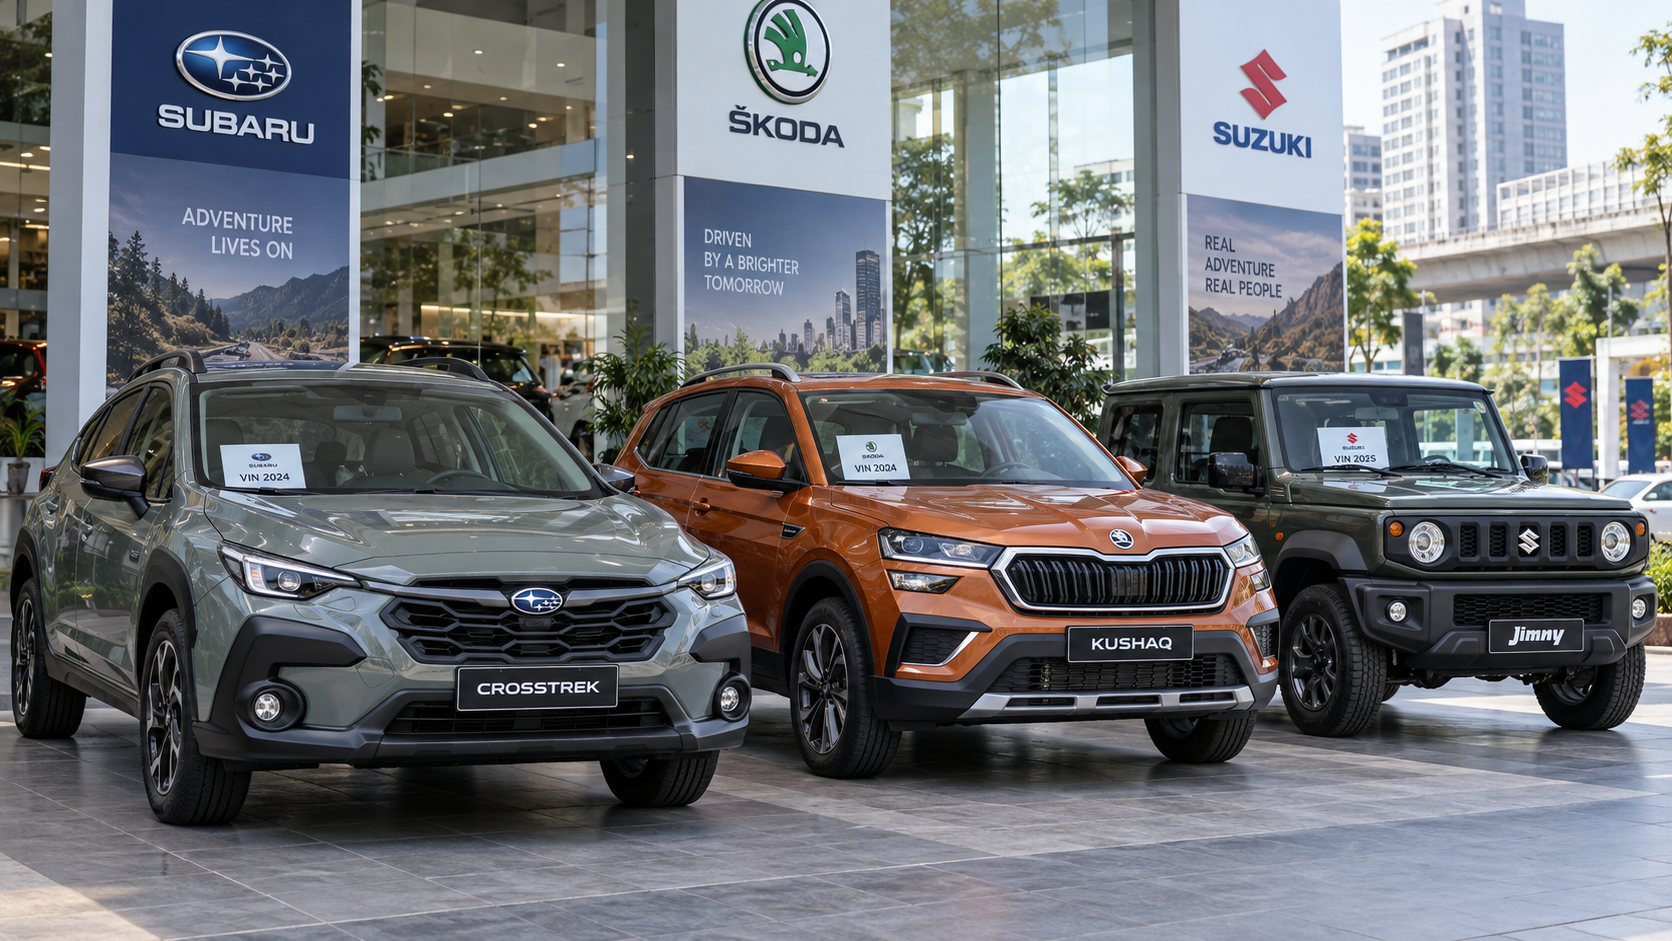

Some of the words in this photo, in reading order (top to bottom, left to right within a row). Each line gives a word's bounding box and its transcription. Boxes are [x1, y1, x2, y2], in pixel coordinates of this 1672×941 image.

[157, 103, 315, 145] SUBARU
[728, 104, 845, 149] ŠKODA
[1213, 121, 1312, 159] SUZUKI
[181, 207, 293, 234] ADVENTURE
[211, 235, 261, 257] LIVES
[265, 240, 293, 260] ON
[704, 228, 752, 248] DRIVEN
[1205, 234, 1236, 253] REAL
[704, 251, 721, 268] BY
[724, 253, 735, 269] A
[738, 254, 800, 275] BRIGHTER
[1204, 256, 1276, 278] ADVENTURE
[703, 274, 785, 296] TOMORROW
[1205, 277, 1236, 295] REAL
[1239, 280, 1283, 299] PEOPLE
[854, 464, 872, 473] VIN
[873, 463, 897, 473] 2024
[1334, 455, 1351, 463] VIN
[239, 473, 260, 482] VIN
[262, 472, 291, 482] 2024
[1091, 636, 1173, 651] KUSHAQ
[1507, 626, 1565, 646] Jimny
[476, 680, 600, 696] CROSSTREK
